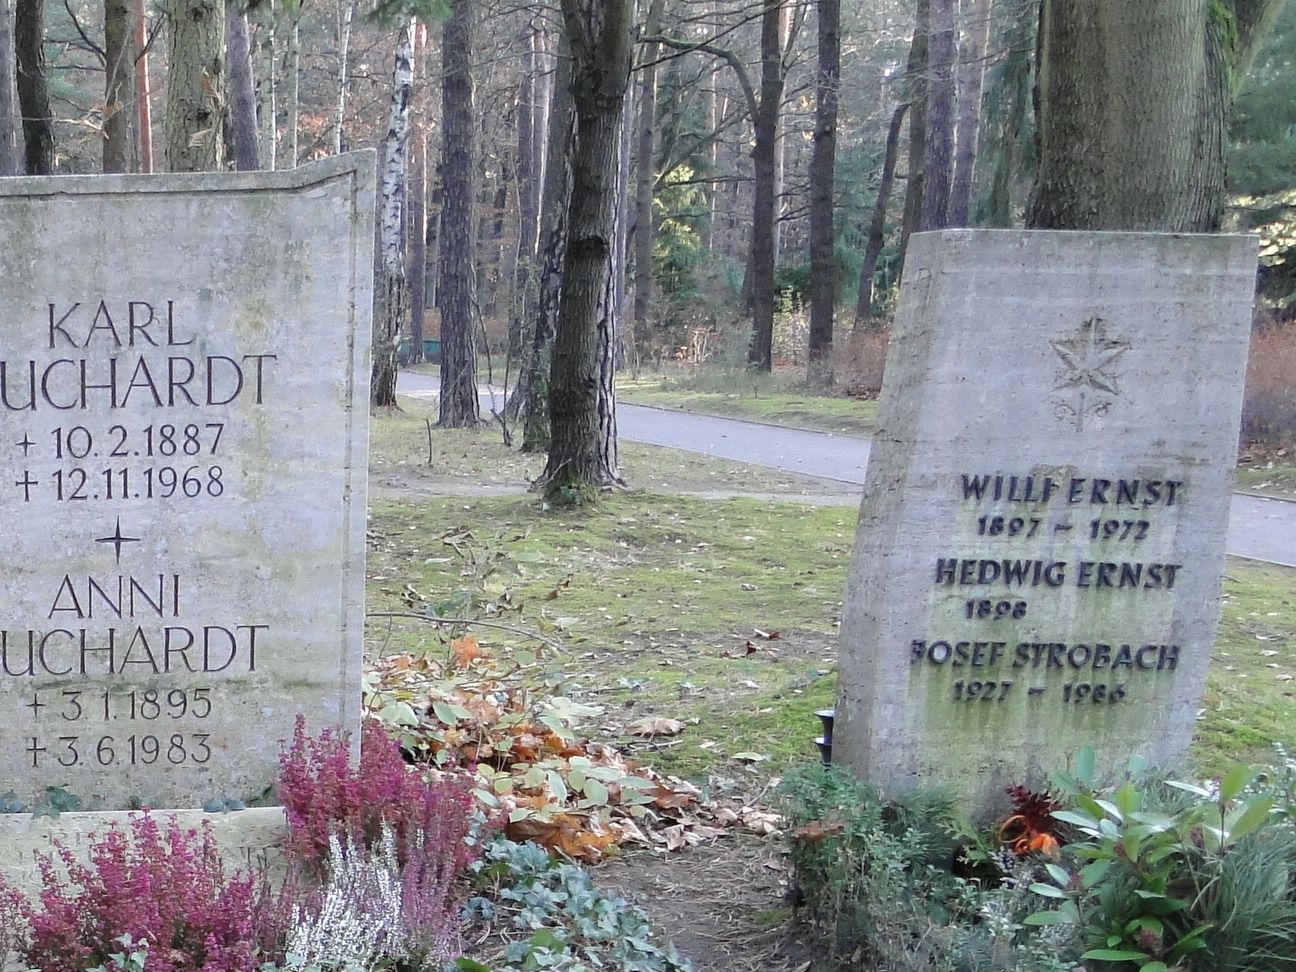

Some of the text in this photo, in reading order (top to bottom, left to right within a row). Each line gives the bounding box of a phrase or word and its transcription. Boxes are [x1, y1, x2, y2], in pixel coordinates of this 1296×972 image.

[48, 299, 194, 349] KARL
[960, 473, 1184, 506] WILLI ERNST
[977, 515, 1042, 538] 1897
[1090, 519, 1151, 541] 1972
[935, 558, 1184, 589] HEDWIG ERNST
[48, 574, 181, 620] ANNI
[965, 600, 1028, 620] 1898
[910, 639, 1182, 671] JOSEF STROBACH
[953, 680, 1015, 703] 1927
